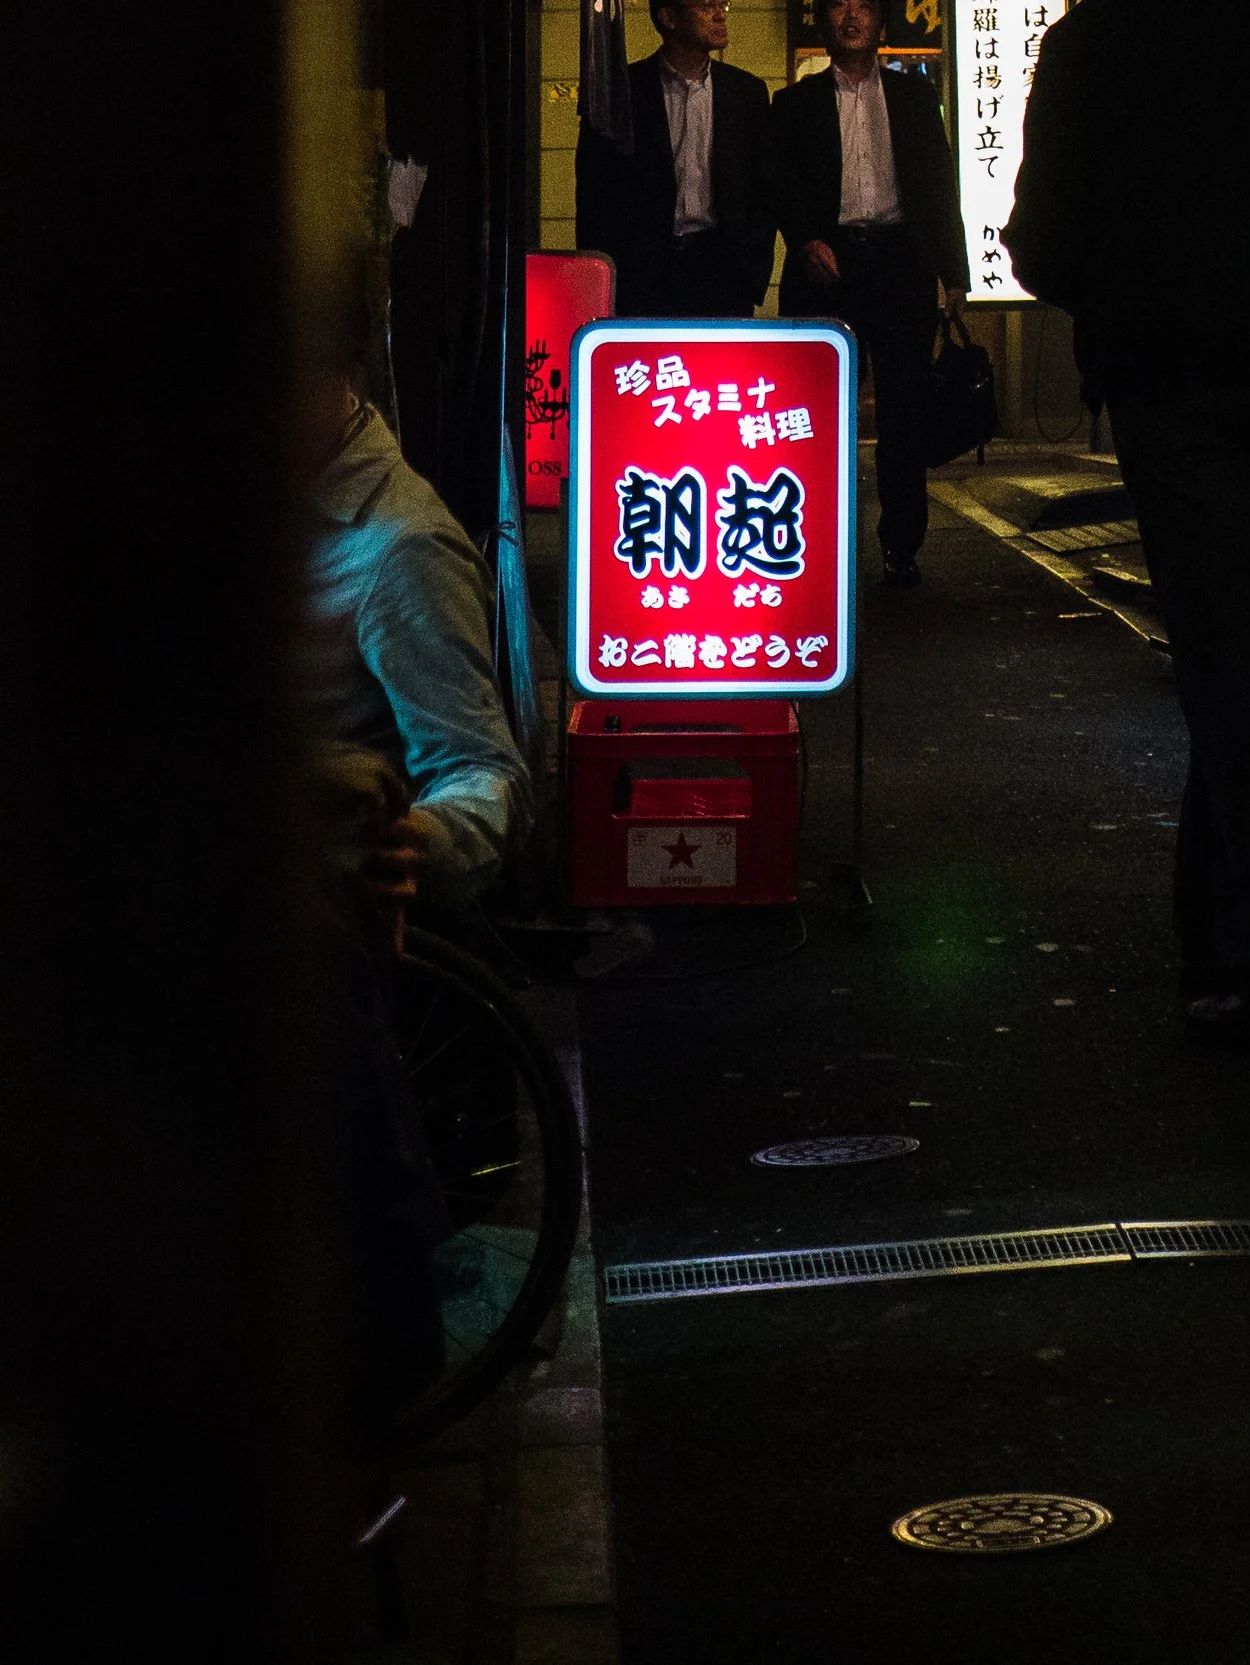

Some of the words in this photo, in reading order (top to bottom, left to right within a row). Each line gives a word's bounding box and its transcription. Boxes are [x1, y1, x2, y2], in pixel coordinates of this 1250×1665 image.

[981, 224, 1003, 290] かめや
[614, 355, 691, 396] 珍品
[651, 376, 776, 428] スタミナ
[738, 407, 815, 449] 料理
[615, 466, 805, 579] 朝起
